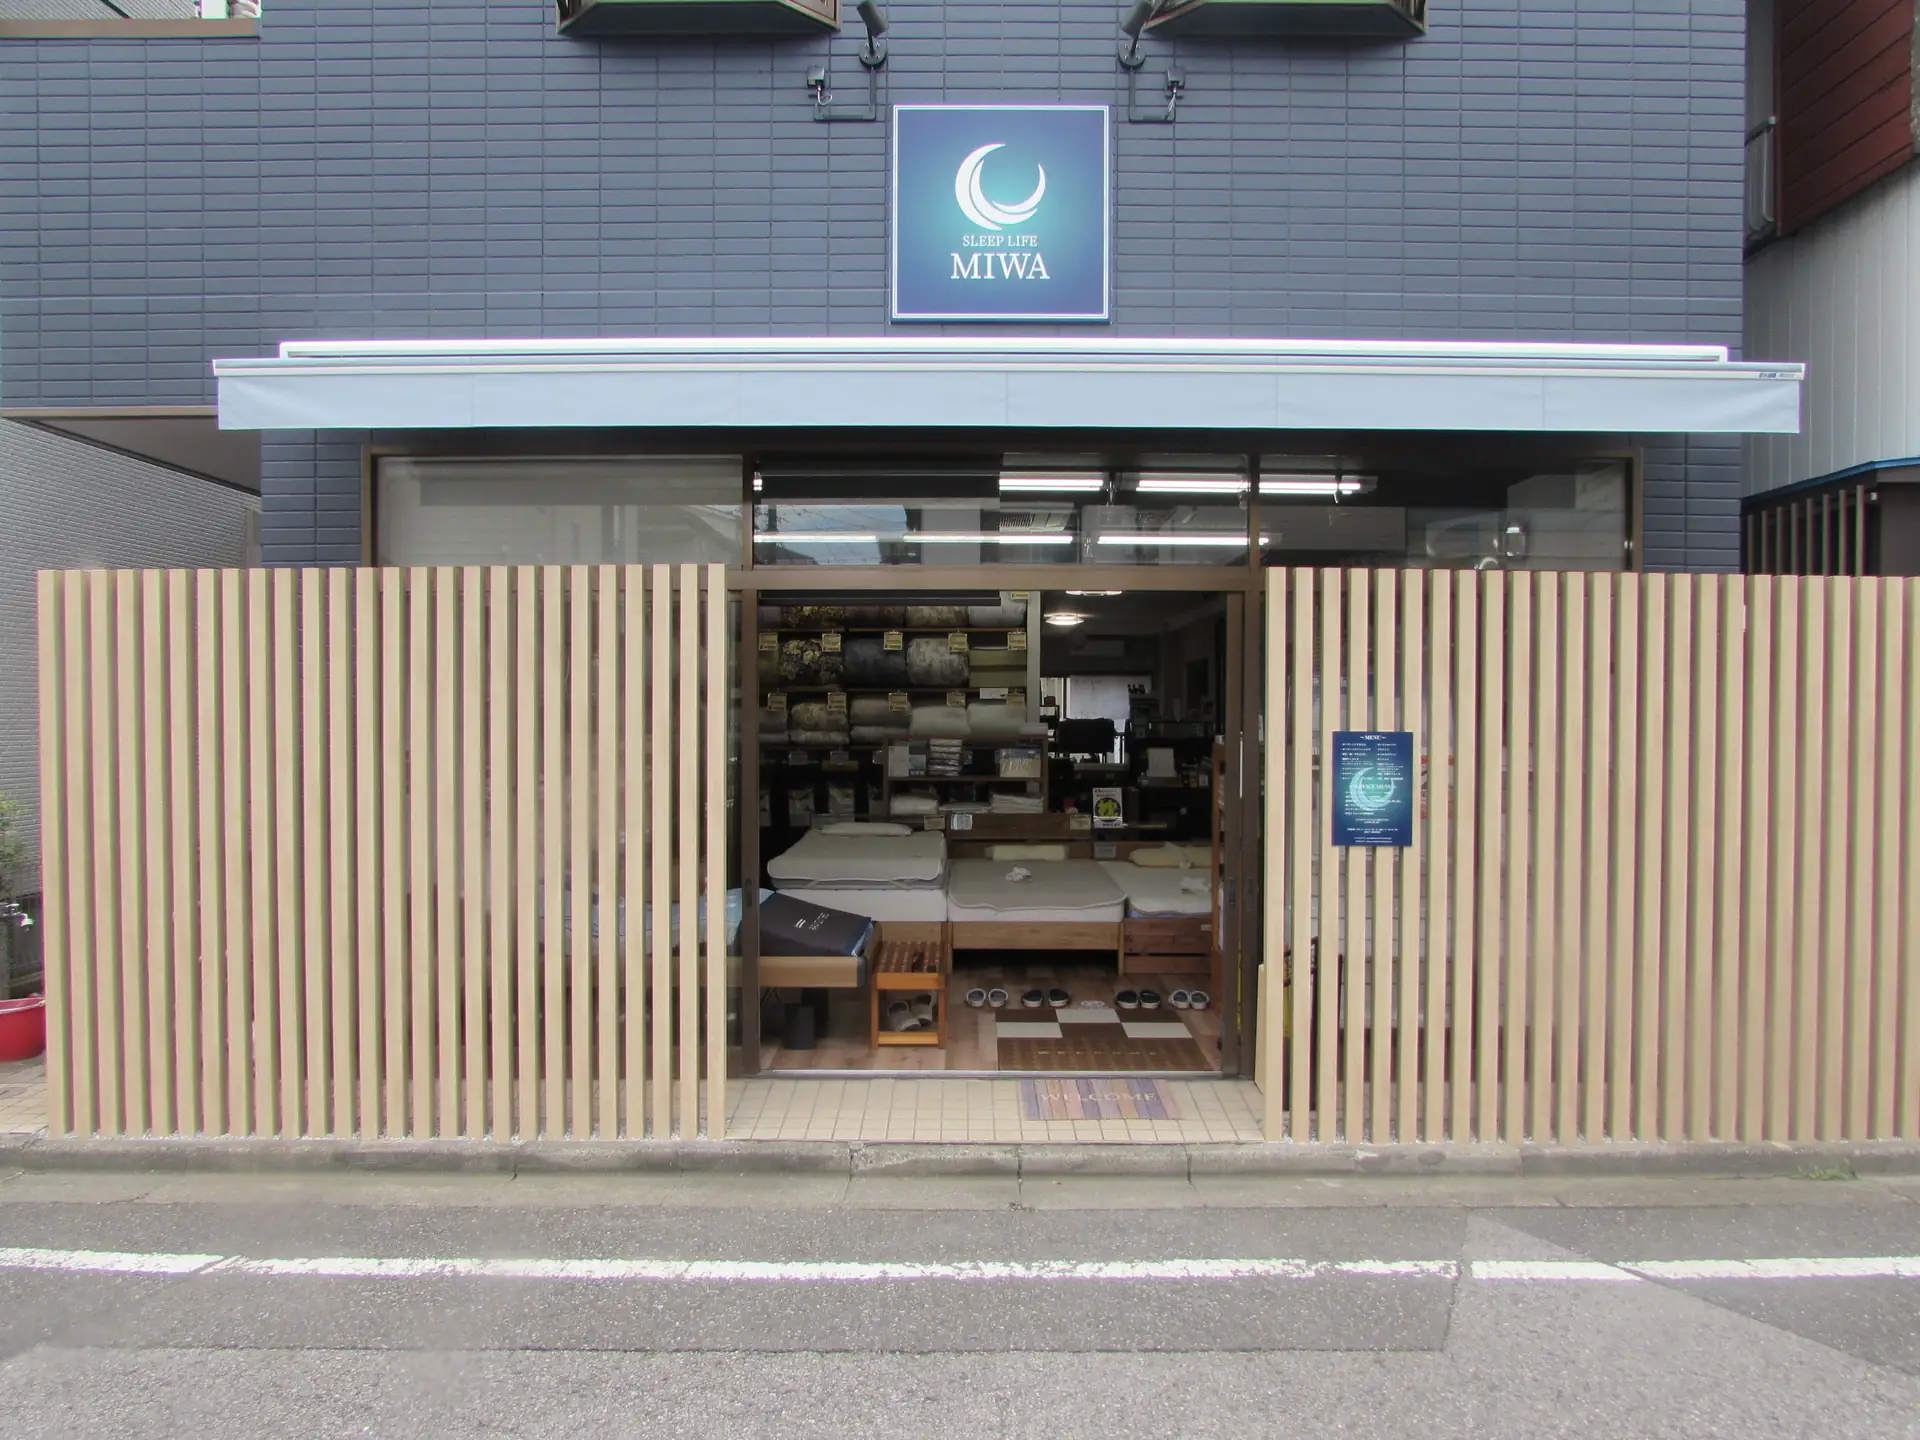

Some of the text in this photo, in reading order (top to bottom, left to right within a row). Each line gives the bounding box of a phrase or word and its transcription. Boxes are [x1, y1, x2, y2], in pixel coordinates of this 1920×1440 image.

[962, 235, 1038, 247] SLEEP LIFE
[950, 252, 1051, 280] MIWA
[1040, 1092, 1157, 1101] WELCOME
